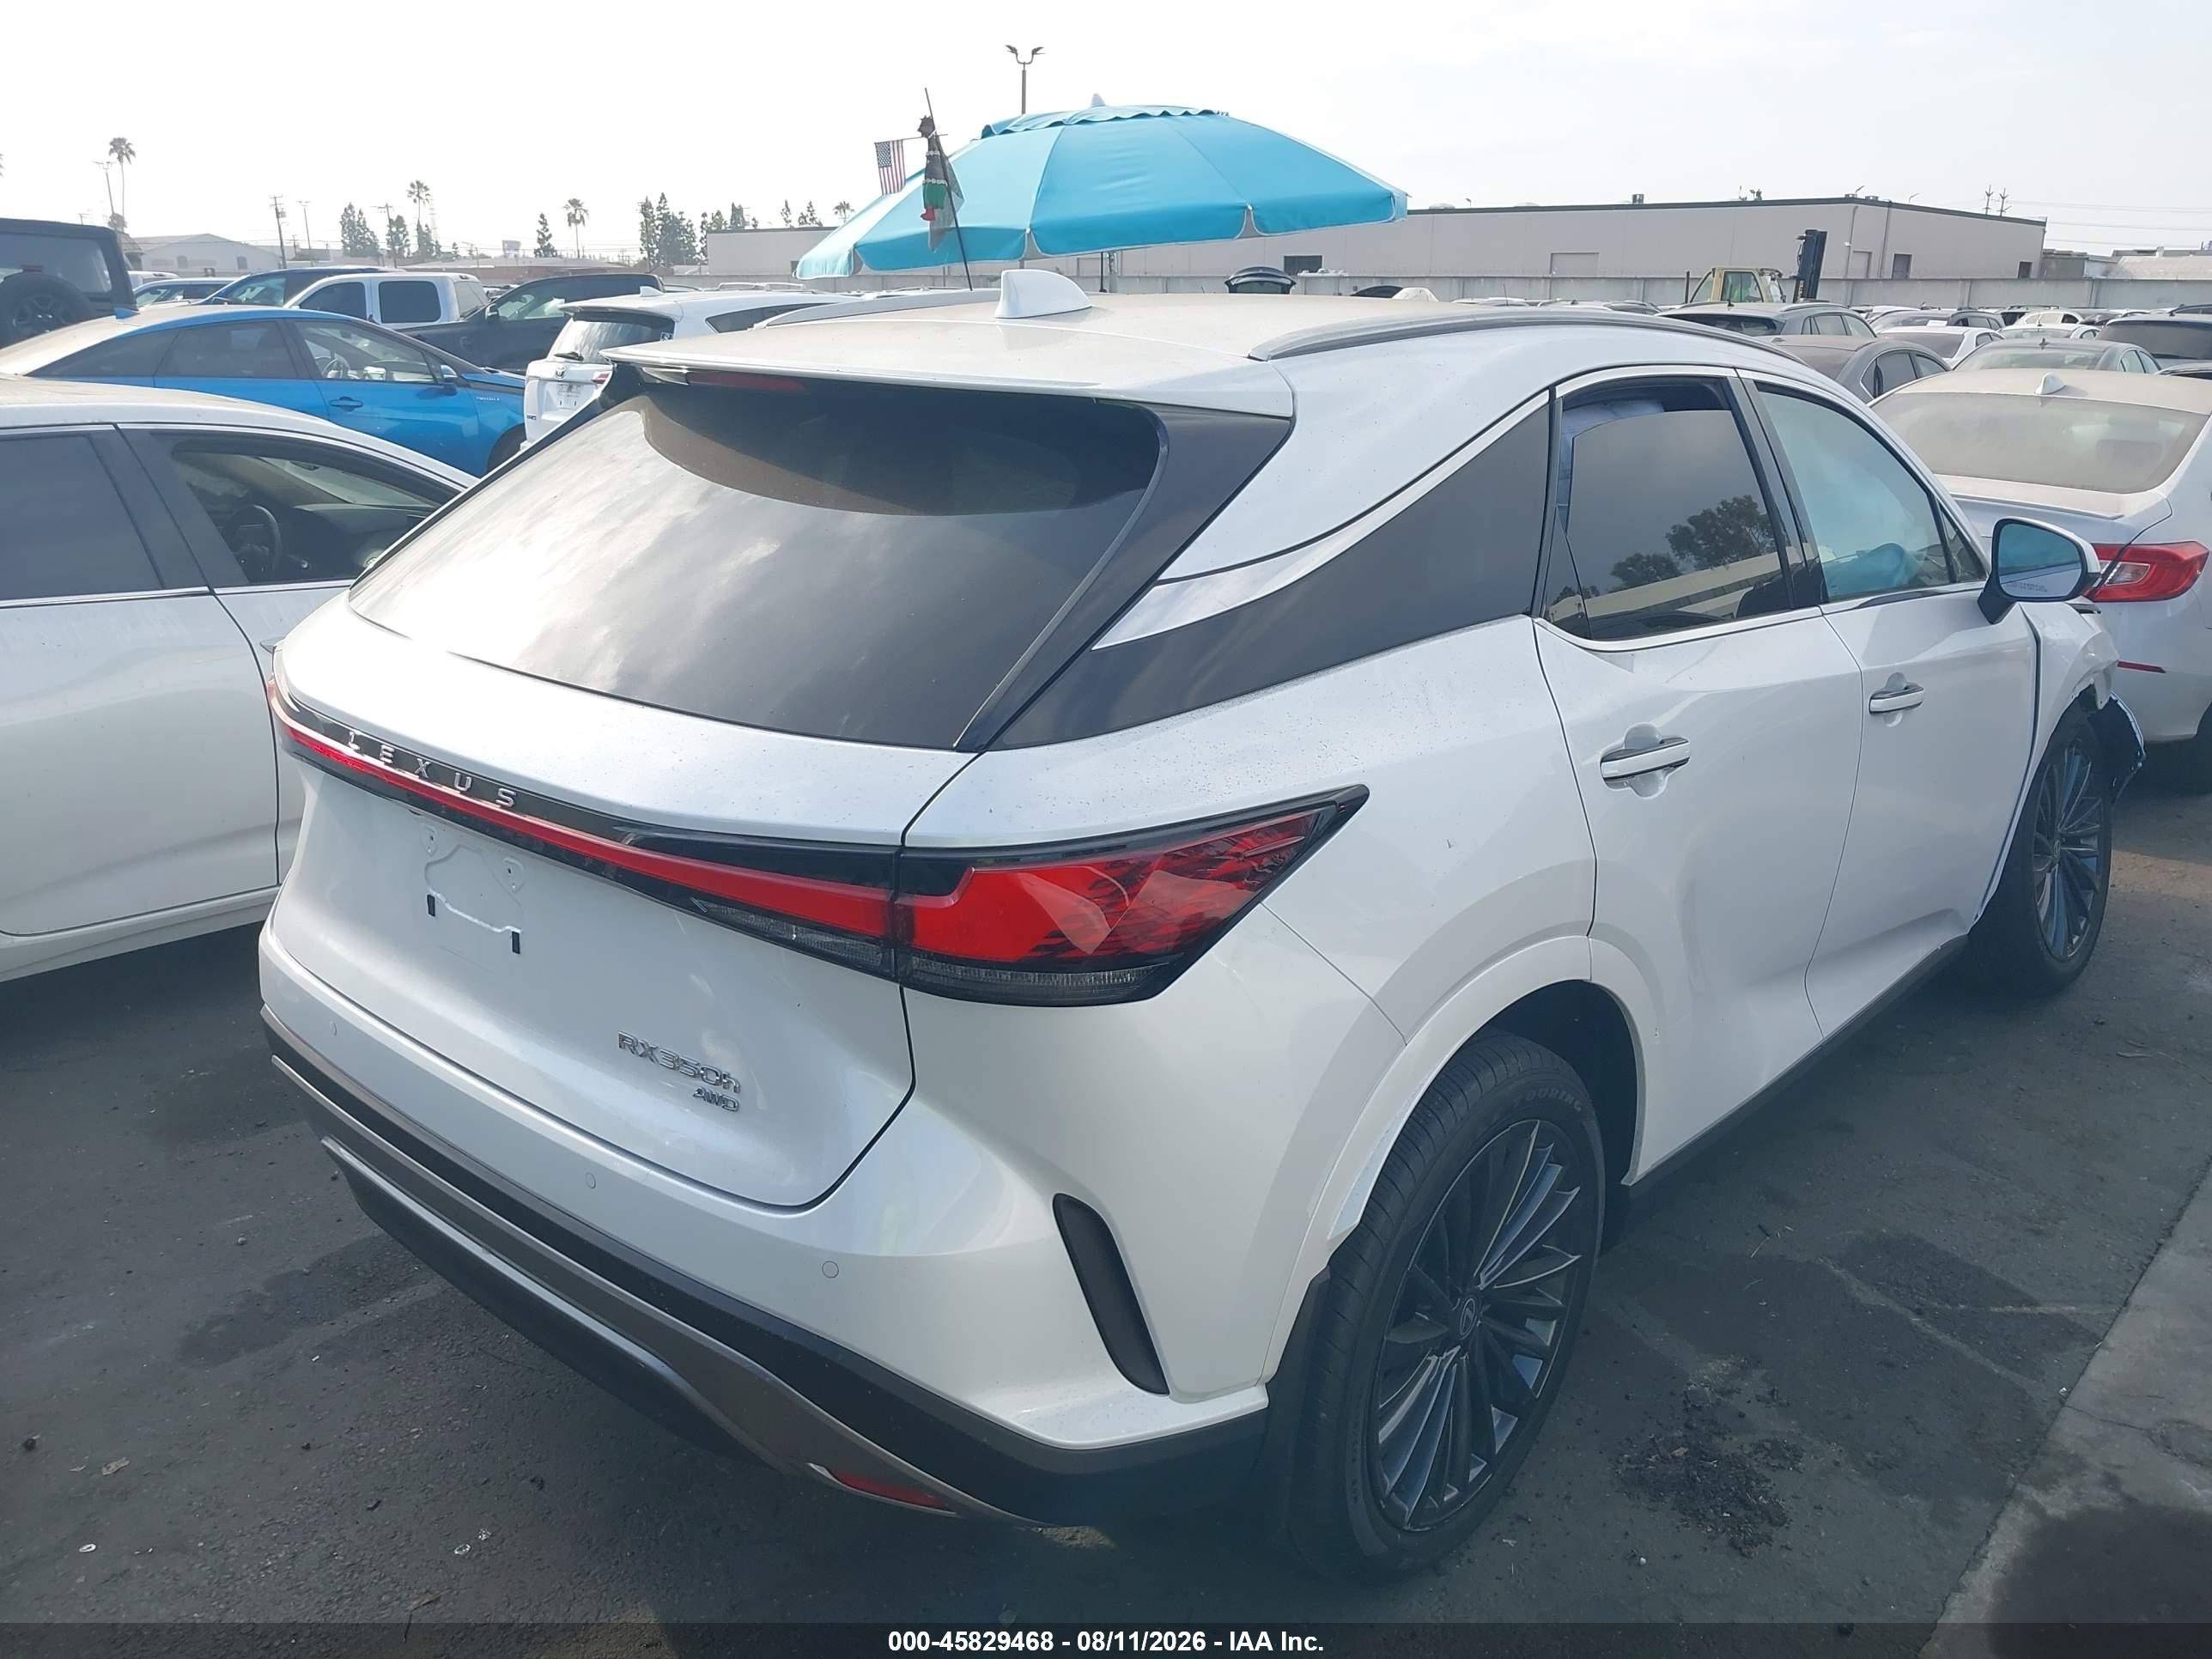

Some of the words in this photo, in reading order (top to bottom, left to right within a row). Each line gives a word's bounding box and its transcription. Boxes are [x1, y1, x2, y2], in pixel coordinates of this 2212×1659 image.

[349, 731, 515, 808] LEXUS
[618, 1030, 740, 1094] RX350h
[692, 1086, 739, 1112] AWD
